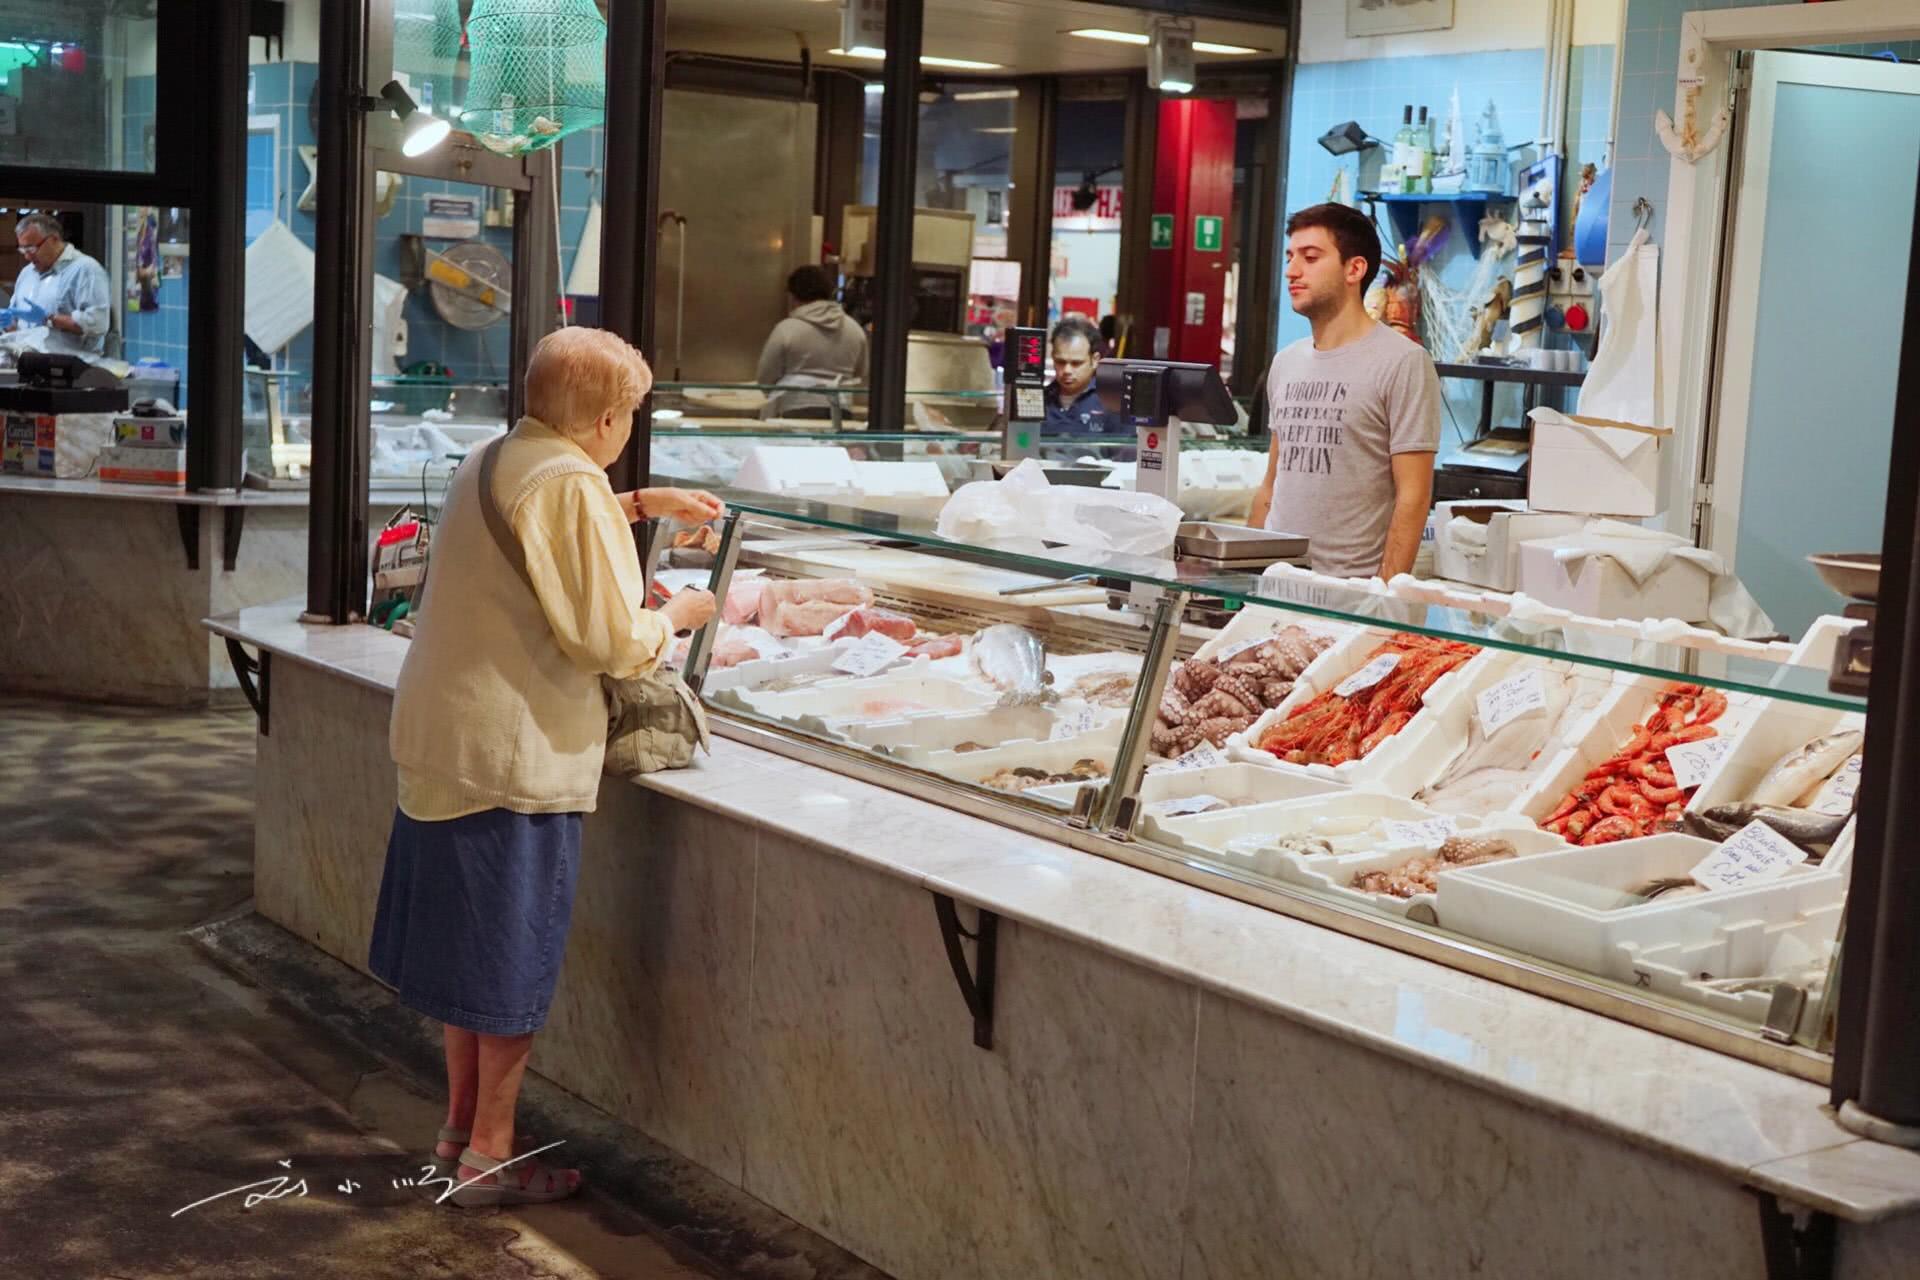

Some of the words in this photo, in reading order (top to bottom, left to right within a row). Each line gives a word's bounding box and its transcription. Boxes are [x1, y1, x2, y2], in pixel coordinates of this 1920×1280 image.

[1284, 381, 1331, 402] NOBODY
[1332, 382, 1349, 402] IS
[1275, 407, 1347, 421] PERFECT
[1316, 425, 1344, 445] THE
[1280, 446, 1334, 475] APTAIN
